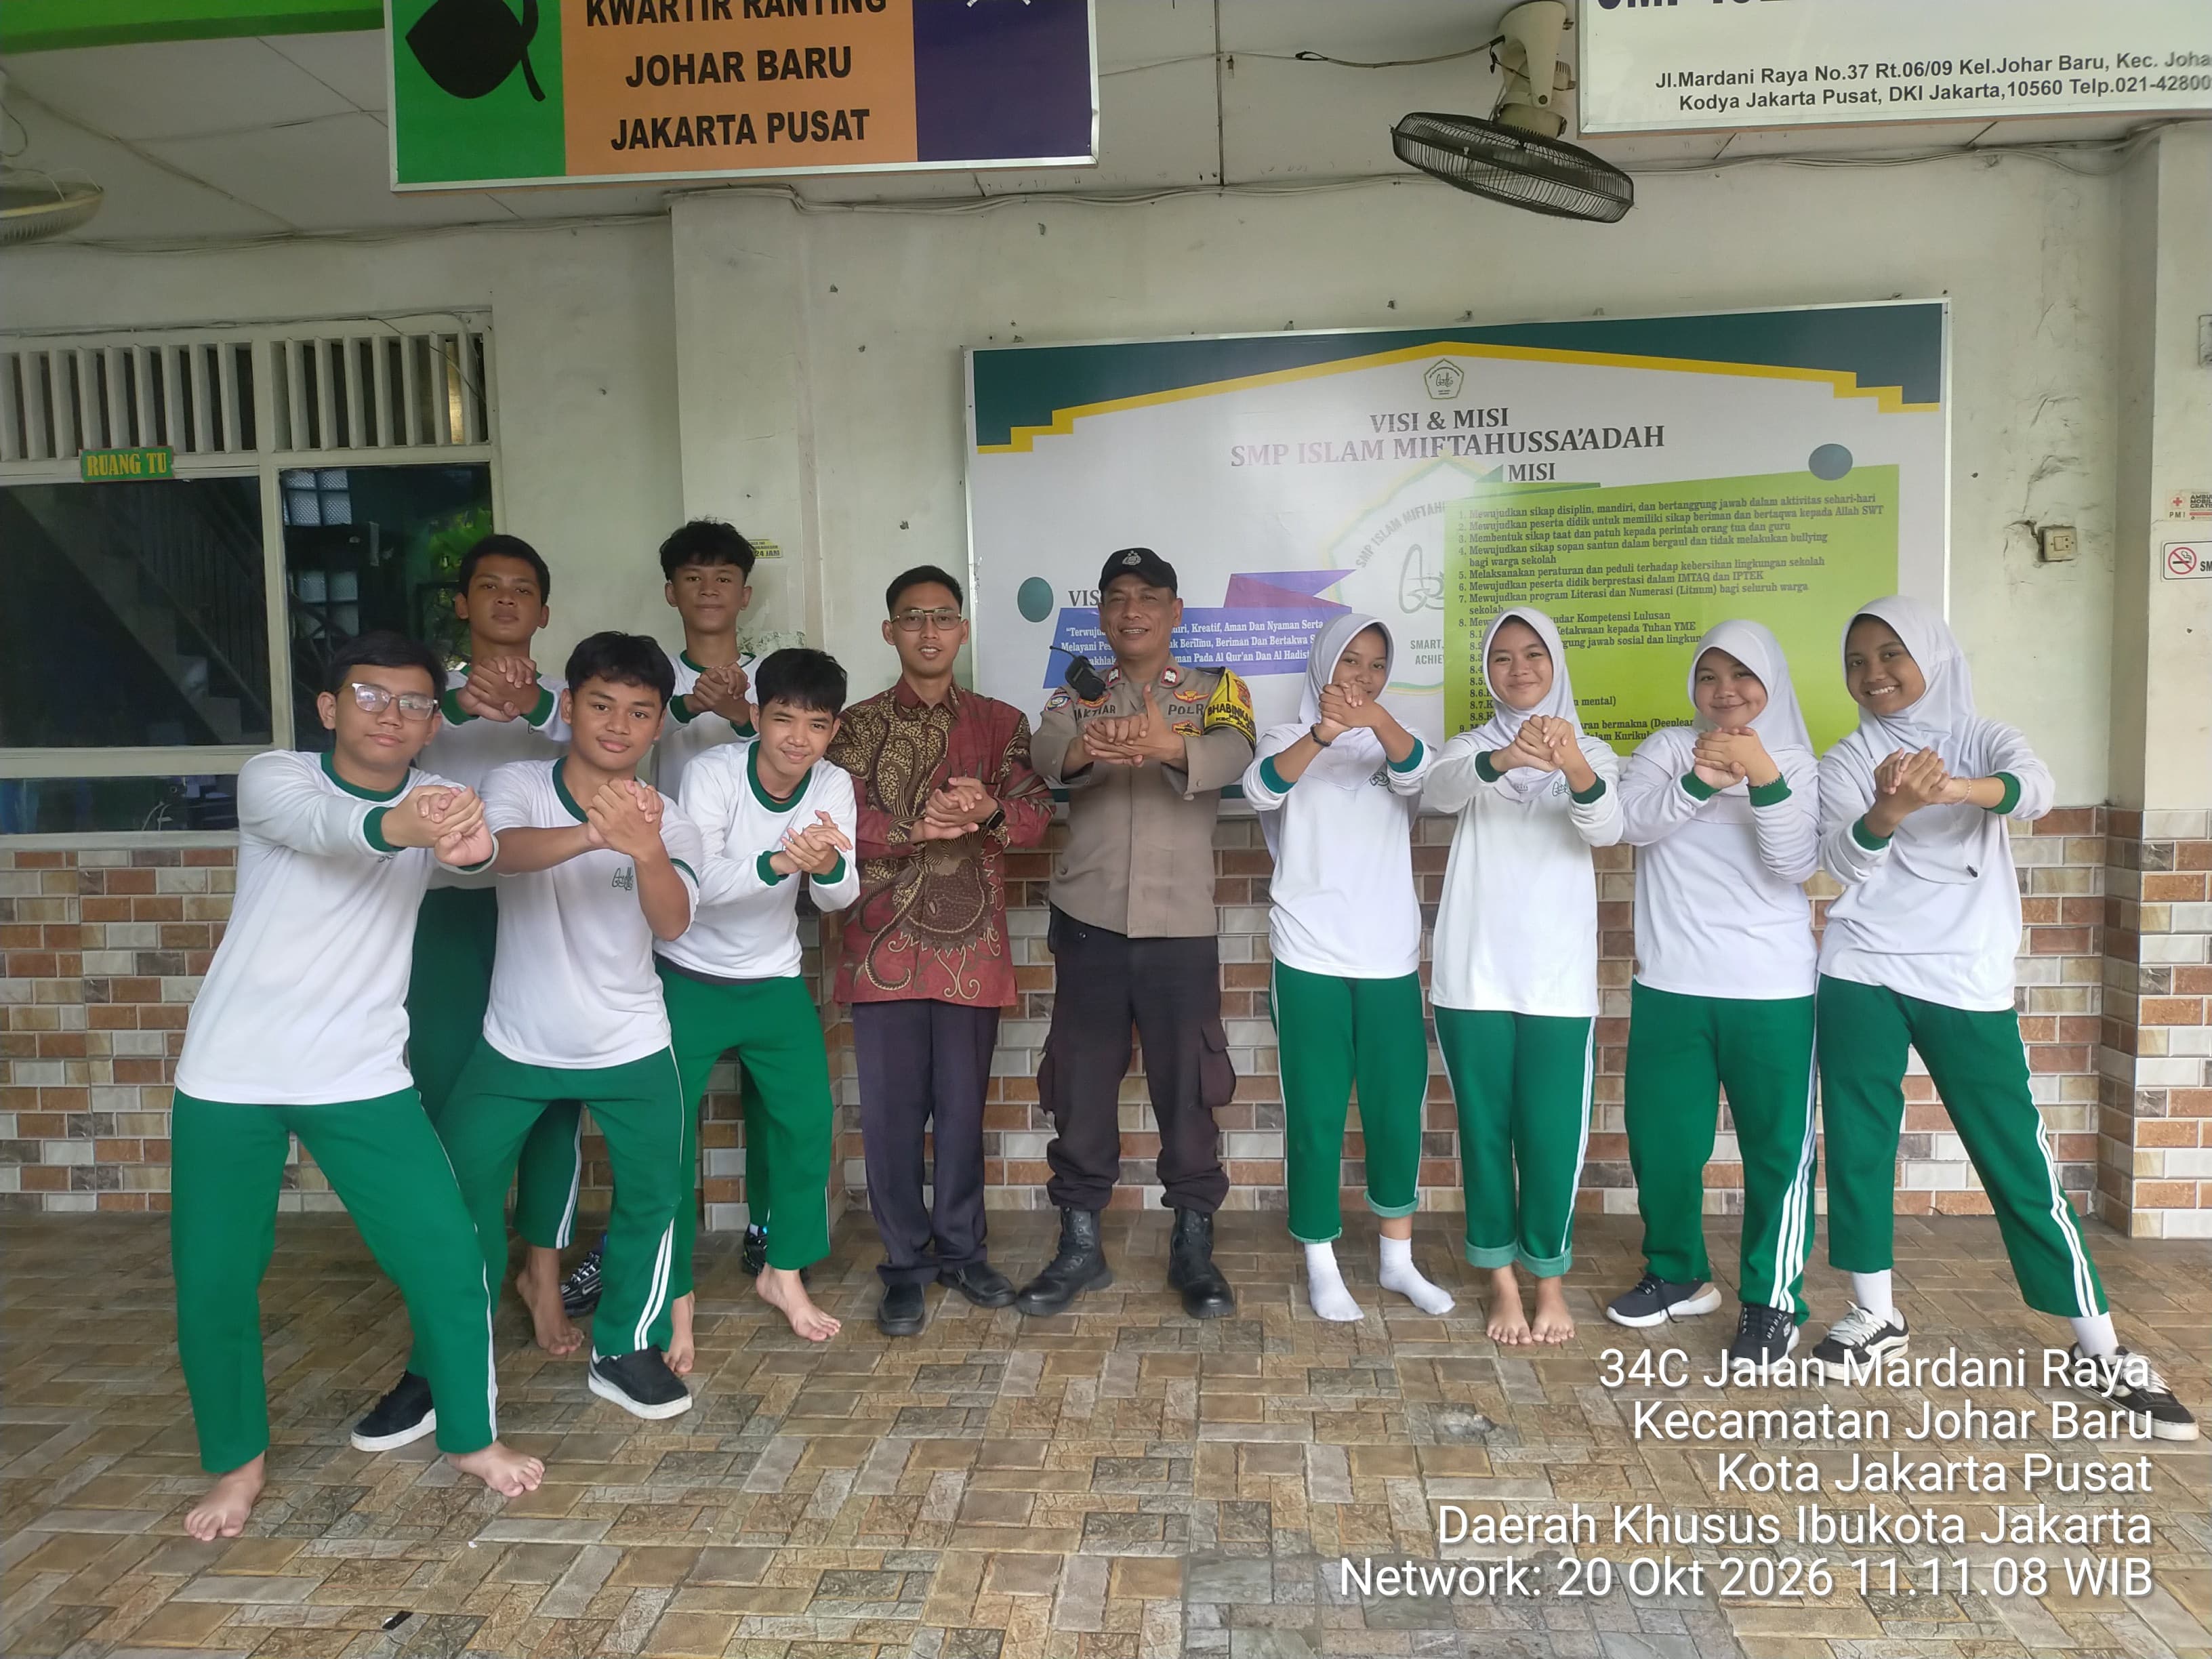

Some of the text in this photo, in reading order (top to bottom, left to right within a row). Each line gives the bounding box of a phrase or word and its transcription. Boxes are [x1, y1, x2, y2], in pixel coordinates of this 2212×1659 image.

[587, 0, 733, 27] KWARTIR
[625, 46, 853, 88] JOHAR BARU
[1656, 50, 2212, 88] Jl.Mardani Raya No.37 Rt.06/09 Kel.Johar Baru, Kec. Joha
[1680, 75, 2212, 114] Kodya Jakarta Pusat, DKI Jakarta,10560 Telp.021-42800
[611, 109, 870, 151] JAKARTA PUSAT
[1370, 407, 1509, 434] VISI & MISI
[1230, 444, 1289, 468] SMP
[1298, 438, 1385, 464] ISLAM
[86, 453, 167, 476] RUANG TU
[1507, 462, 1557, 482] MISI
[1530, 508, 1555, 518] sikap
[1557, 506, 1594, 516] disiplin,
[1597, 504, 1636, 515] mandiri,
[1658, 500, 1717, 513] bertanggung
[1719, 499, 1747, 511] jawab
[1749, 499, 1778, 507] dalam
[1780, 497, 1822, 506] aktivitas
[1824, 495, 1876, 504] sehari-hari
[1469, 520, 1528, 532] Mewujudkan
[1530, 519, 1564, 530] peserta
[1592, 517, 1620, 525] untuk
[1622, 515, 1663, 524] memiliki
[1665, 514, 1691, 525] sikap
[1694, 513, 1732, 521] beriman
[1734, 512, 1752, 520] dan
[1754, 510, 1798, 521] bertaqwa
[1799, 509, 1833, 520] kepada
[1835, 508, 1860, 516] Allah
[1862, 506, 1884, 515] SWT
[1469, 532, 1523, 541] Membentuk
[1525, 531, 1551, 541] sikap
[1593, 529, 1621, 539] patuh
[1623, 527, 1657, 538] kepada
[1658, 526, 1699, 537] perintah
[1701, 527, 1729, 535] orang
[1768, 525, 1791, 533] guru
[1469, 534, 1828, 556] Mewujudkan sikap sopan santun dalam bergaul dan tidak melakukan bullying
[1469, 556, 1557, 568] bagi warga sekolah
[1469, 558, 1825, 578] Melaksanakan peraturan dan peduli terhadap kebersihan lingkungan sekolah
[1469, 581, 1527, 592] Mewujudkan
[1530, 579, 1564, 590] peserta
[1592, 577, 1645, 588] berprestasi
[1647, 575, 1675, 583] dalam
[1677, 574, 1711, 585] IMTAQ
[1733, 572, 1764, 580] IPTEK
[1068, 590, 1099, 607] VIS
[1469, 592, 1528, 604] Mewujudkan
[1530, 593, 1568, 602] program
[1571, 590, 1607, 598] Literasi
[1609, 589, 1626, 597] dan
[1629, 588, 1673, 596] Numerasi
[1719, 586, 1740, 596] bagi
[1742, 584, 1778, 592] seluruh
[1780, 585, 1809, 593] warga
[1191, 620, 1324, 634] Kreatif, Aman Dan Nyaman Serta
[1577, 612, 1671, 624] Kompetensi Lulusan
[1607, 624, 1640, 635] kepada
[1061, 640, 1097, 653] Melayani
[1180, 638, 1214, 649] Berilmu,
[1215, 637, 1250, 647] Beriman
[1251, 637, 1268, 646] Dan
[1269, 636, 1308, 645] Bertakwa
[1586, 634, 1664, 649] jawab sosial dan
[1193, 653, 1214, 662] Pada
[1215, 653, 1224, 661] Al
[1255, 651, 1272, 660] Dan
[1273, 651, 1282, 660] Al
[1168, 704, 1205, 716] POLR
[1581, 696, 1616, 707] mental)
[1601, 719, 1648, 729] bermakna
